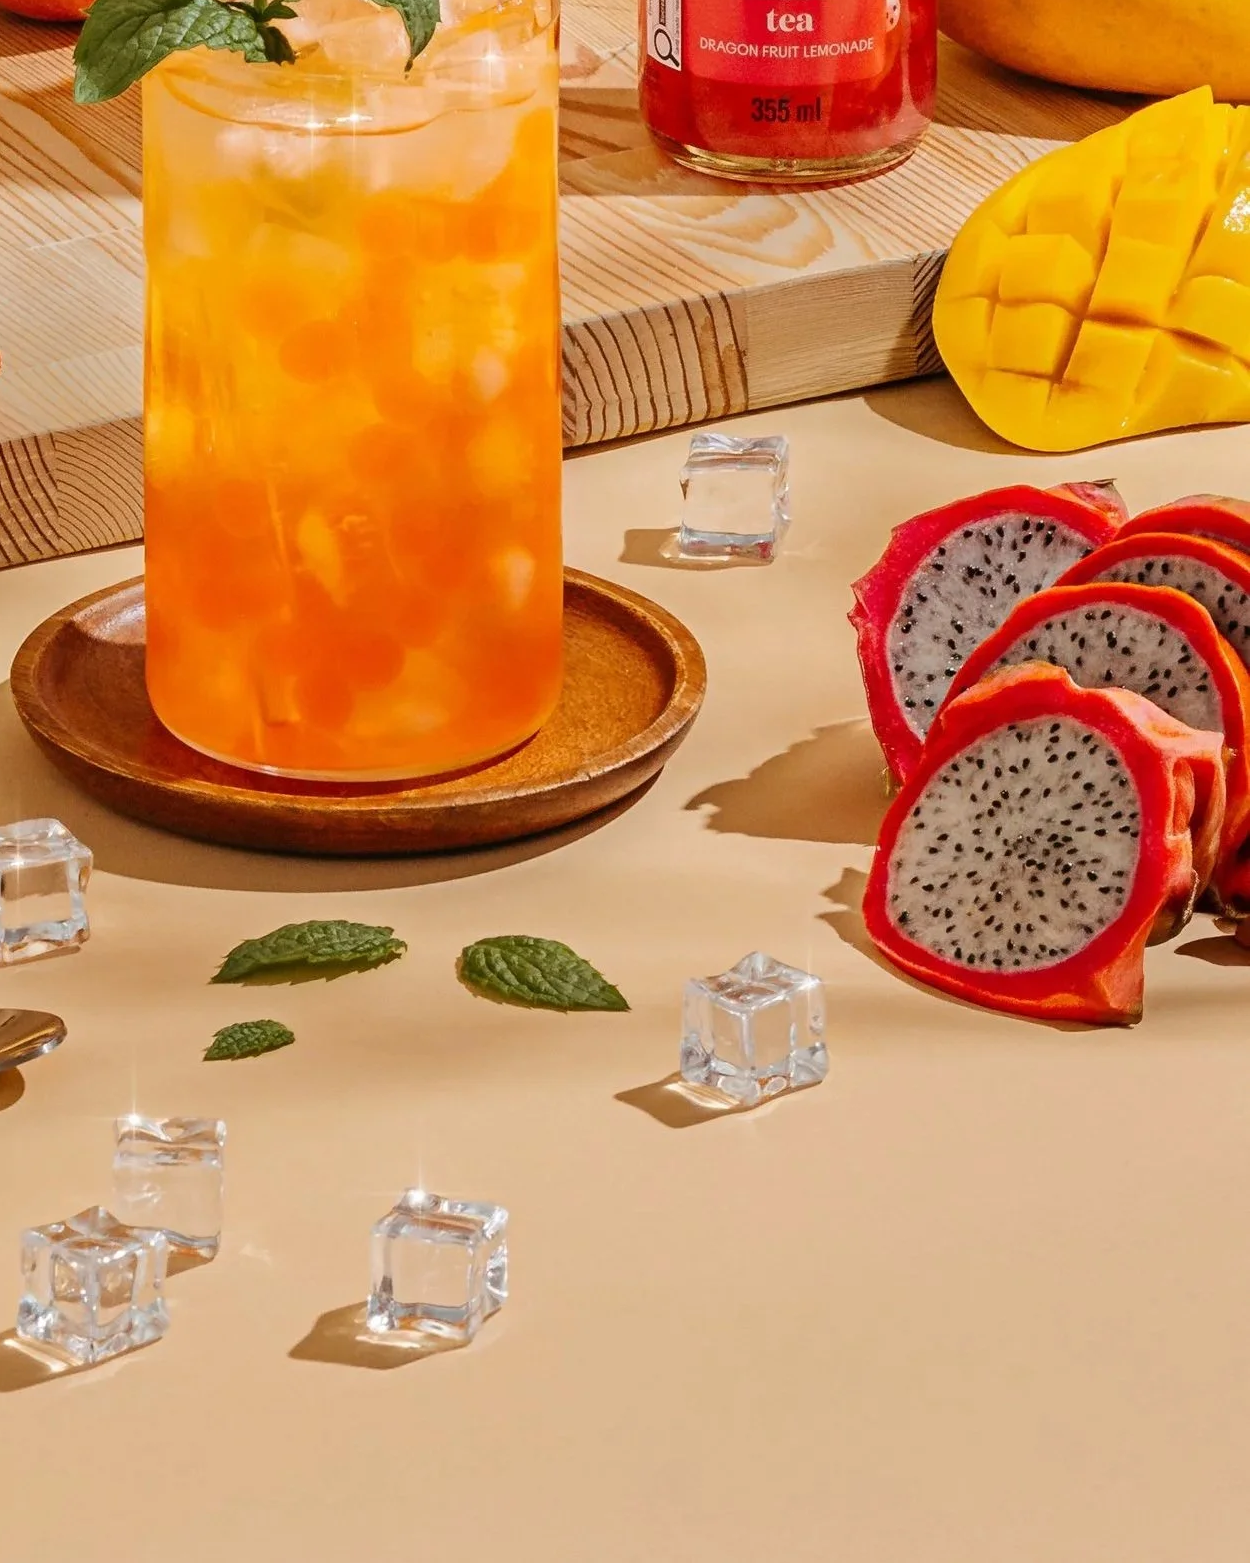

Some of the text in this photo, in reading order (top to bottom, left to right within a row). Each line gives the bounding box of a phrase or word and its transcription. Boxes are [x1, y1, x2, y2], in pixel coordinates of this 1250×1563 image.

[766, 8, 814, 32] tea
[699, 36, 874, 59] DRAGON FRUIT LEMONADE
[751, 96, 821, 123] 355 ml
